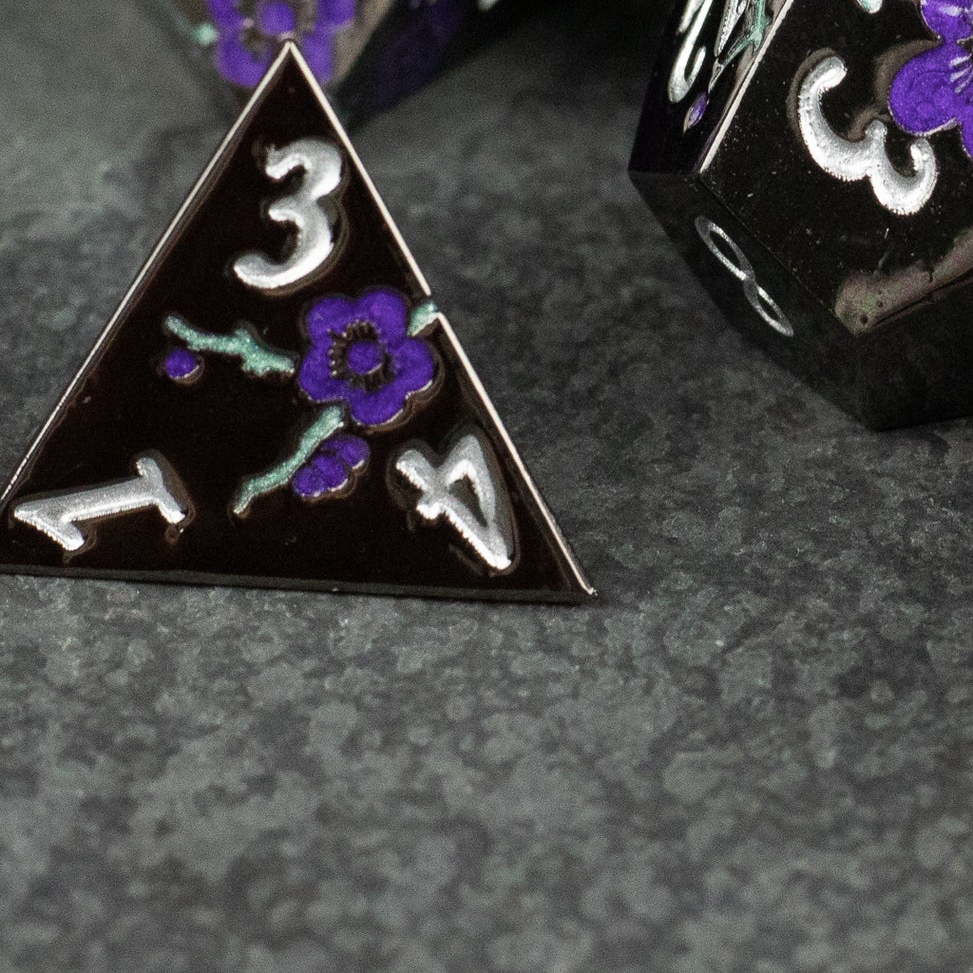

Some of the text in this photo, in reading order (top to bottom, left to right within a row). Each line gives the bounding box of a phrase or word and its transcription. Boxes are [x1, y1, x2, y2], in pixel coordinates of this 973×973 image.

[796, 56, 938, 217] 3
[231, 138, 344, 290] 3
[694, 215, 794, 337] 8
[10, 456, 188, 552] 1
[395, 433, 512, 571] 4
